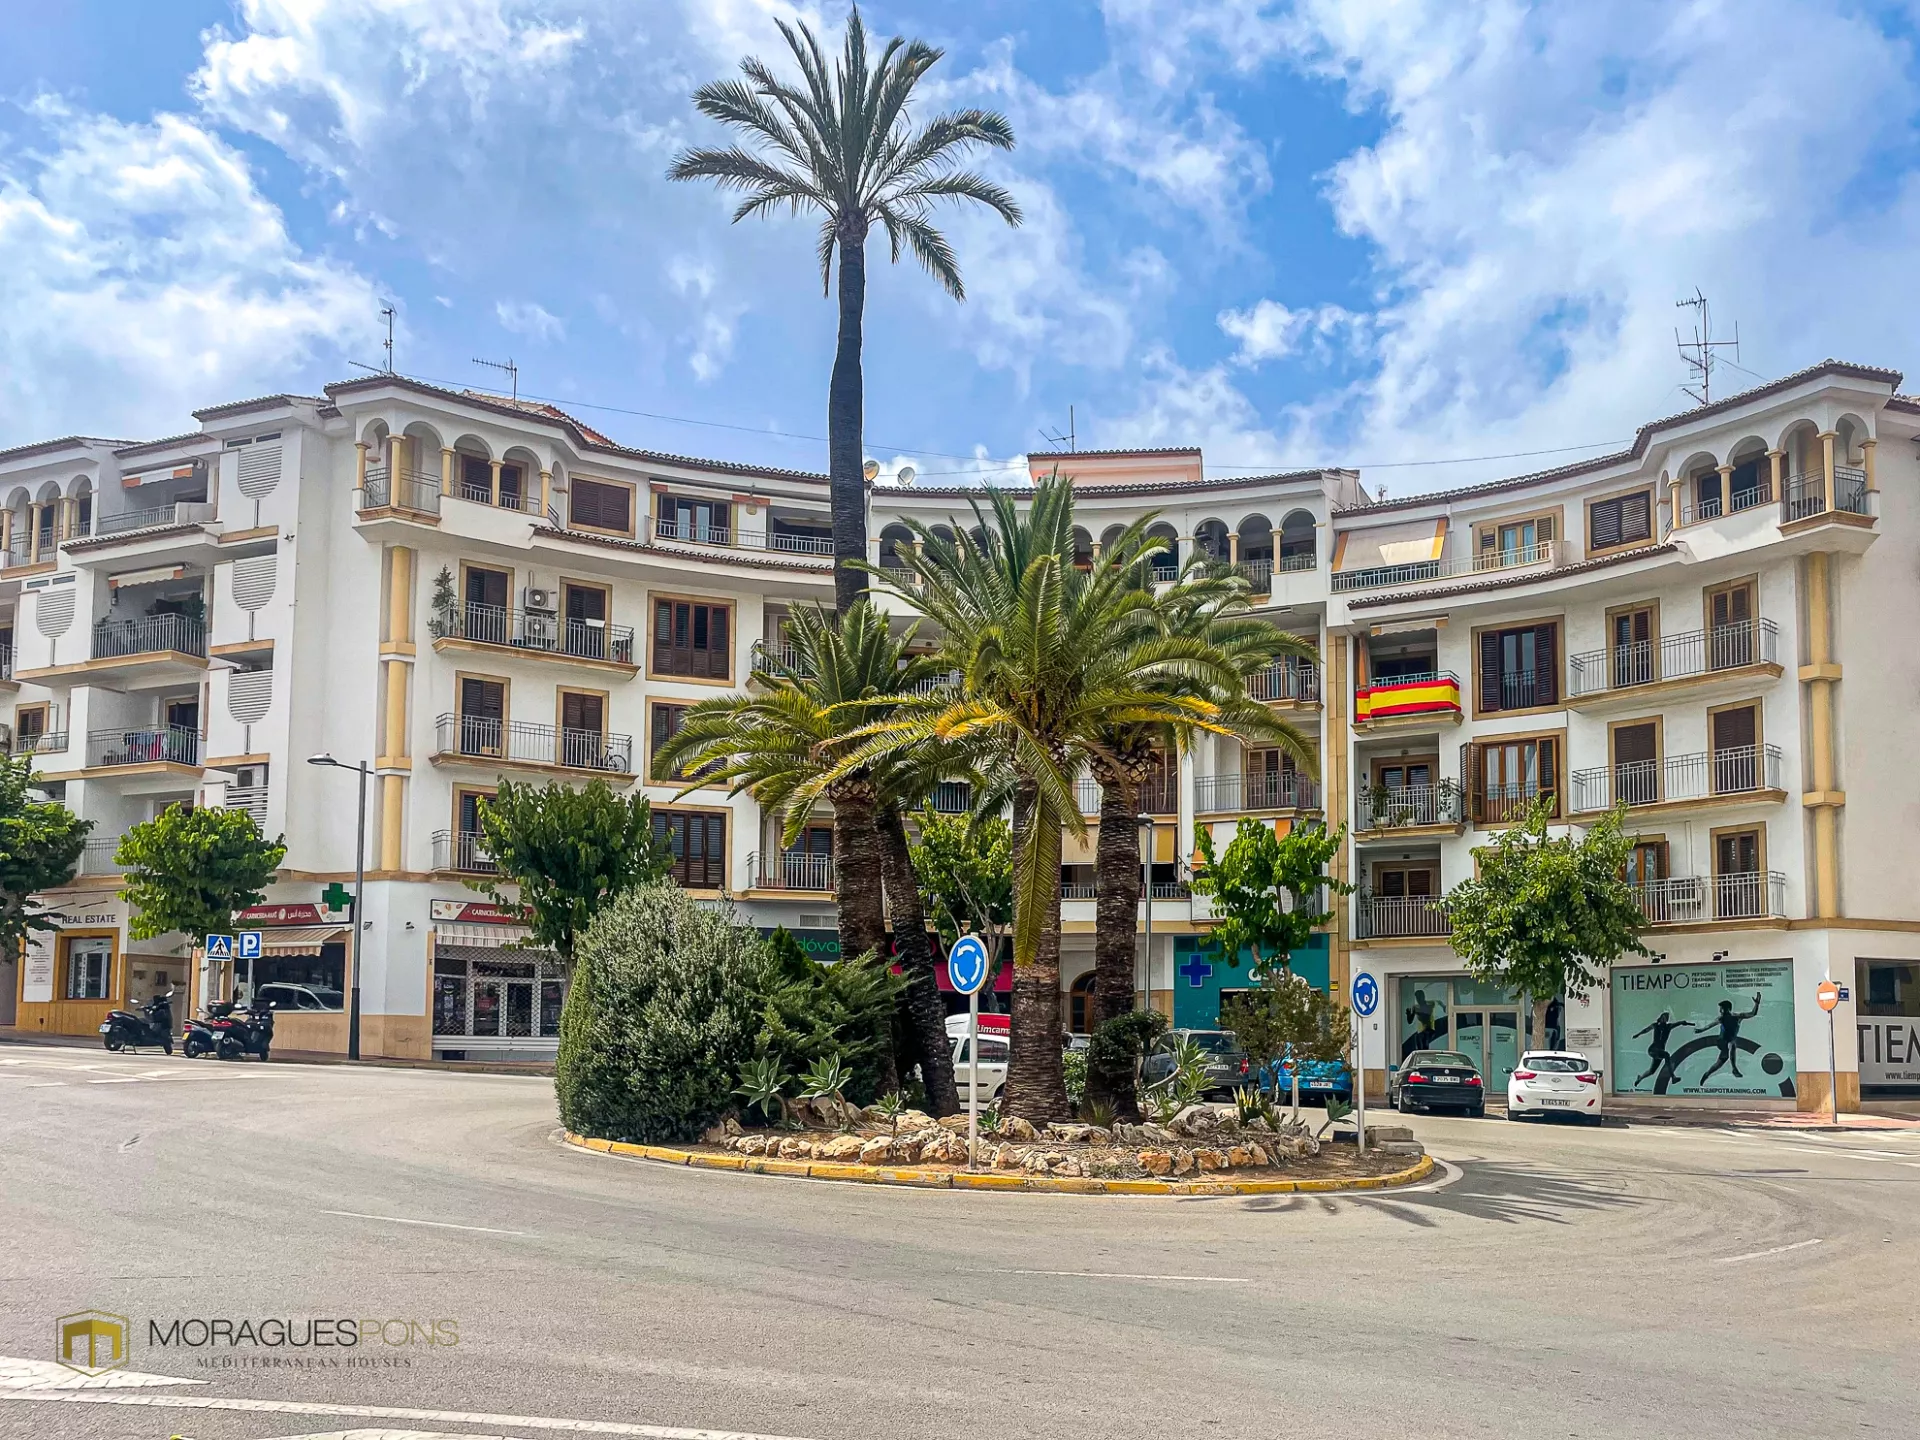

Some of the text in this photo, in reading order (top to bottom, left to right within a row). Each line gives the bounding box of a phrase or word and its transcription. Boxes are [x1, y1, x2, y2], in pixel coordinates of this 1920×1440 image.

[62, 914, 116, 924] REAL ESTATE
[242, 934, 257, 956] P
[1620, 972, 1690, 991] TIEMPO
[1683, 1087, 1767, 1095] WWW.TIEMPOTRAINING.COM
